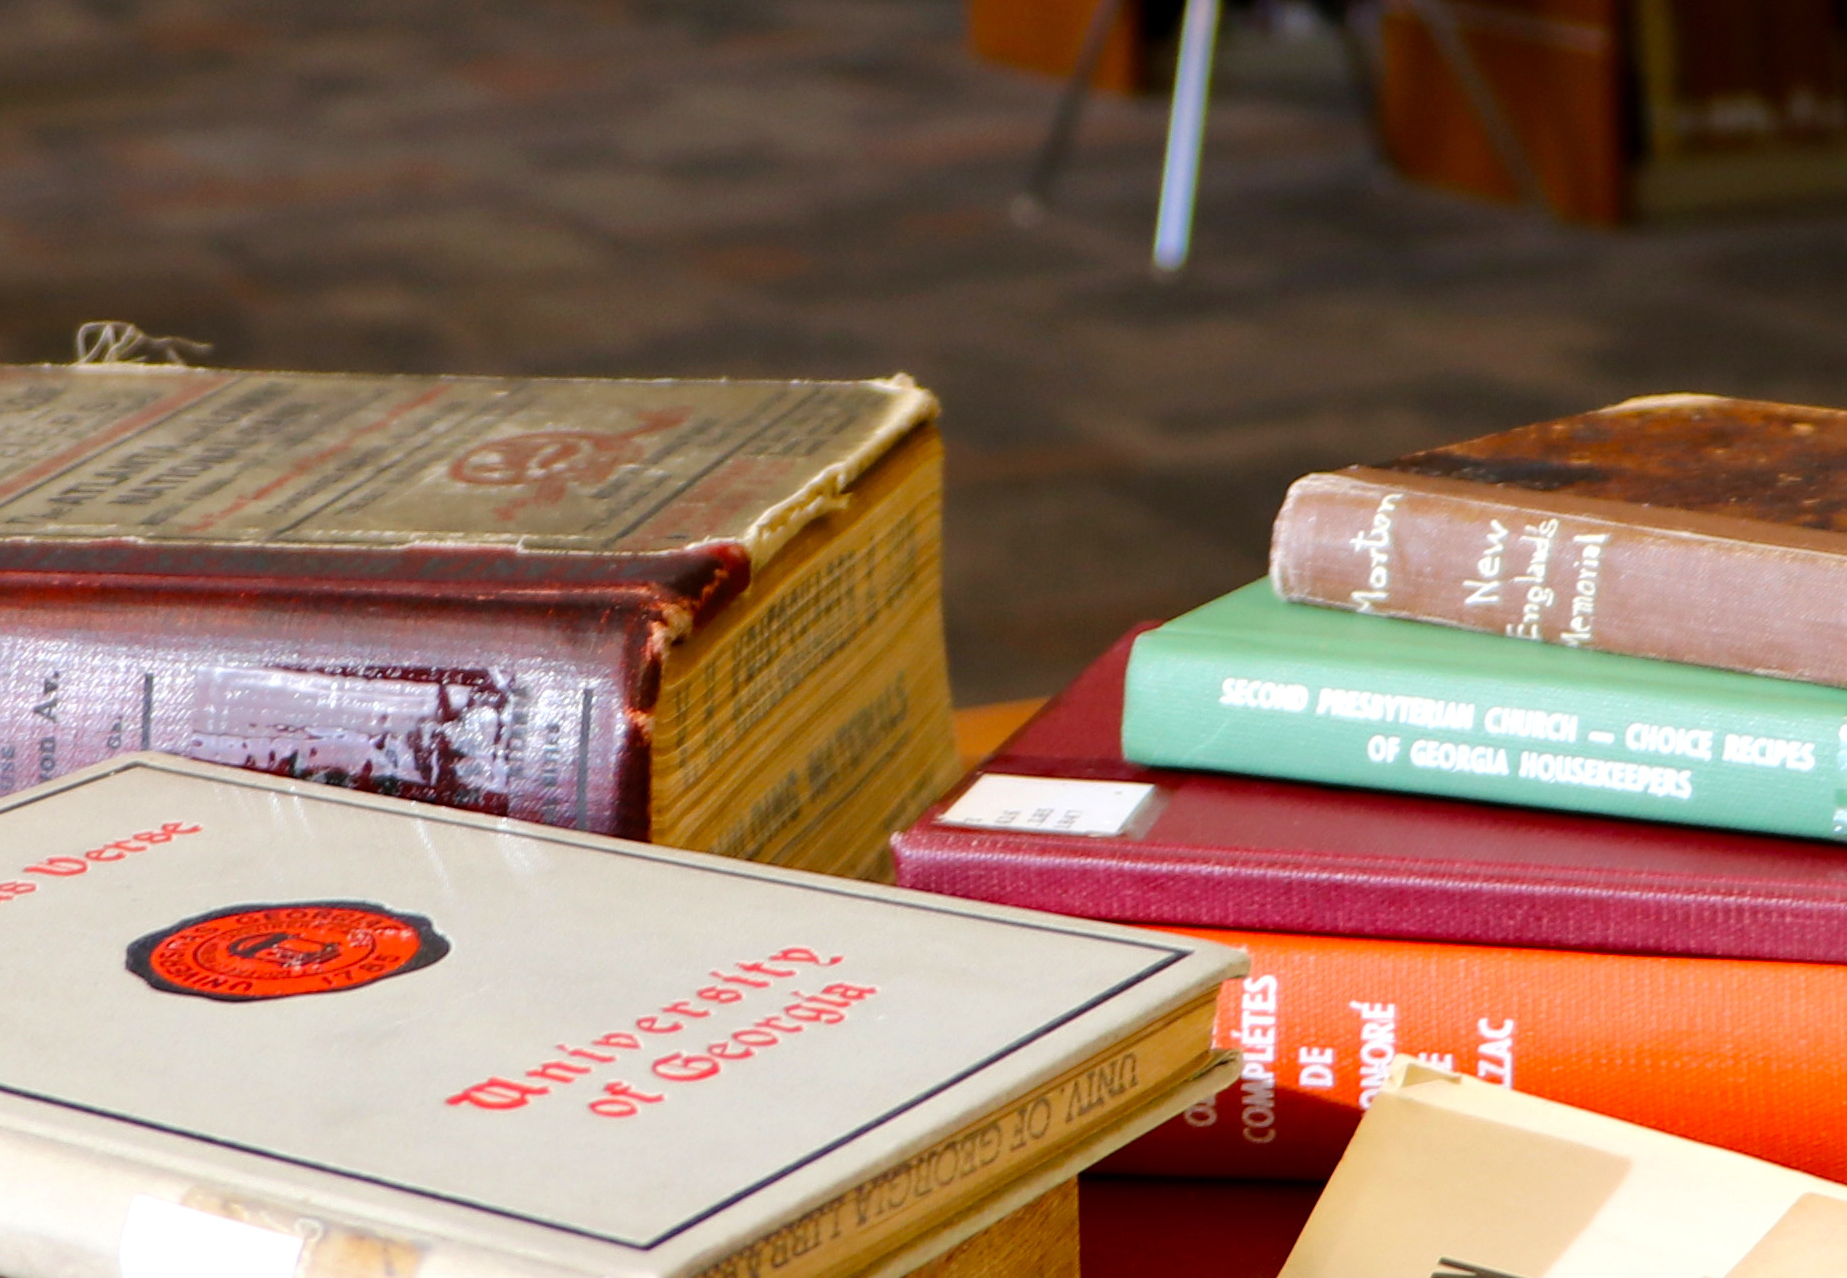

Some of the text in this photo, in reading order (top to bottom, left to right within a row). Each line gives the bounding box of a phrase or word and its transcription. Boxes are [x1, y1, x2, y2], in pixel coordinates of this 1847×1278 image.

[1463, 518, 1510, 607] New
[1506, 517, 1560, 644] England's
[1559, 533, 1612, 649] Memorial
[1219, 678, 1816, 771] SECOND PRESBYTERIAN CHURCH CHOICE RECIPES
[1367, 734, 1694, 800] OF GEORGIA HOUSEKEEPERS
[24, 820, 205, 881] Verse
[322, 953, 400, 988] 1785
[445, 941, 848, 1112] University
[586, 980, 880, 1120] of Georgia
[1298, 1047, 1335, 1087] DE
[1352, 1000, 1396, 1115] ONORÉ
[1418, 1051, 1455, 1072] E
[1477, 1017, 1516, 1088] ZAC
[1009, 1098, 1050, 1153] OF
[1065, 1051, 1139, 1126] UNIV.
[855, 1123, 1002, 1220] GEORGIA
